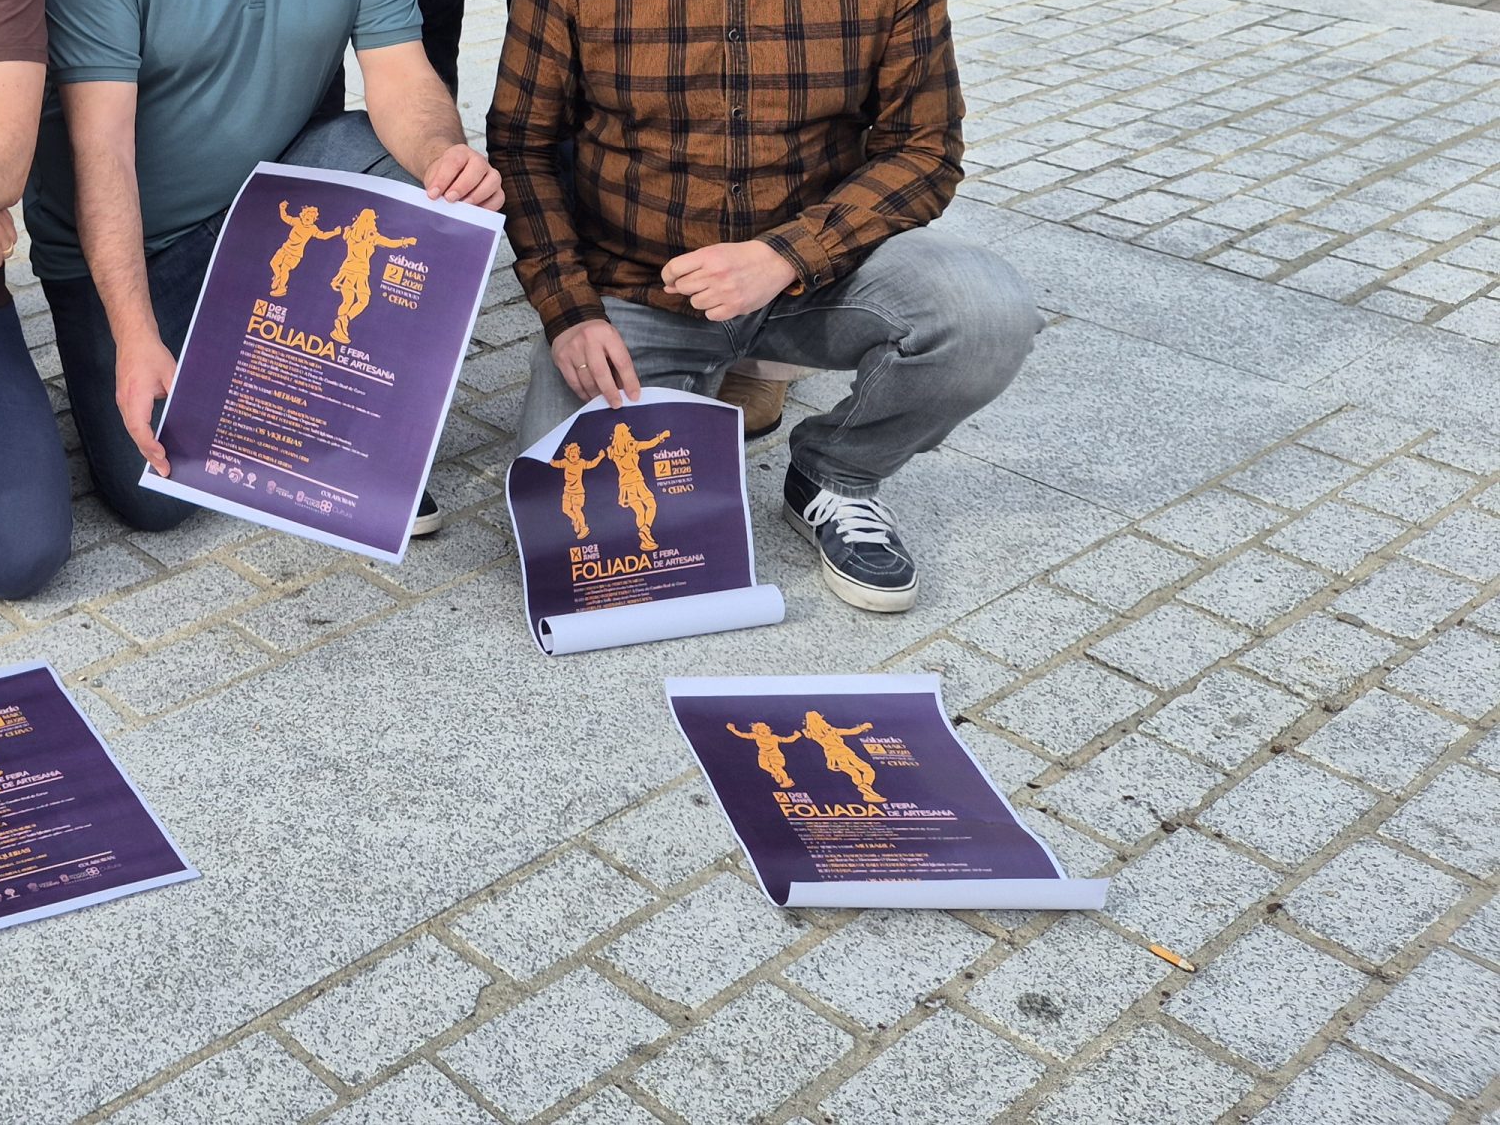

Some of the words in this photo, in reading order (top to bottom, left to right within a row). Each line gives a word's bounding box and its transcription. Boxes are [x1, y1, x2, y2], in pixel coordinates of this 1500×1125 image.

[388, 254, 429, 274] sábado
[404, 269, 426, 282] MAIO
[401, 278, 424, 291] 2026
[388, 293, 418, 310] CERVO
[246, 315, 335, 361] FOLIADA
[337, 354, 349, 366] DE
[339, 345, 347, 354] E
[346, 347, 370, 363] FEIRA
[659, 548, 679, 558] FEIRA
[572, 553, 652, 582] FOLIADA
[653, 561, 664, 569] DE
[5, 770, 30, 781] FEIRA
[2, 781, 15, 790] DE
[779, 803, 886, 817] FOLIADA
